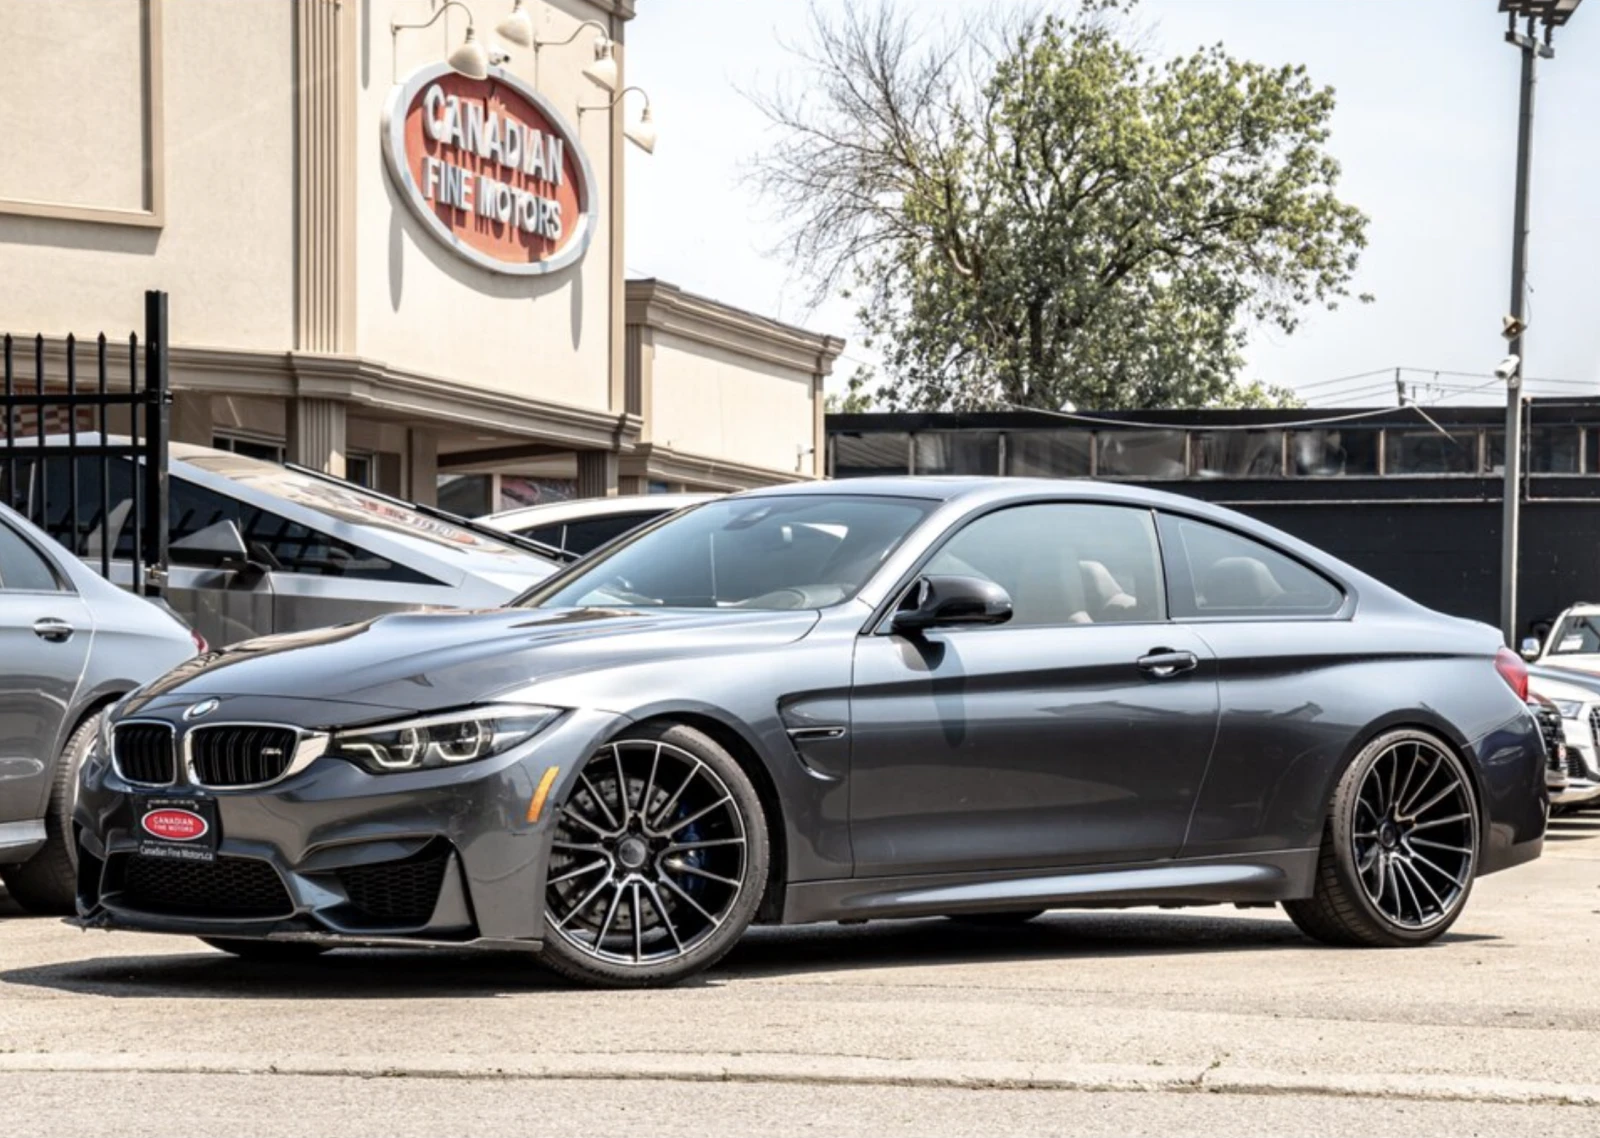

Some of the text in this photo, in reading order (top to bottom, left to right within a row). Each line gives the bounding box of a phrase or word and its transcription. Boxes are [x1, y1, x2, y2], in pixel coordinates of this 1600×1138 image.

[423, 84, 563, 185] CANADIAN
[423, 157, 562, 240] FINE MOTORS
[153, 816, 194, 825] CANADIAN
